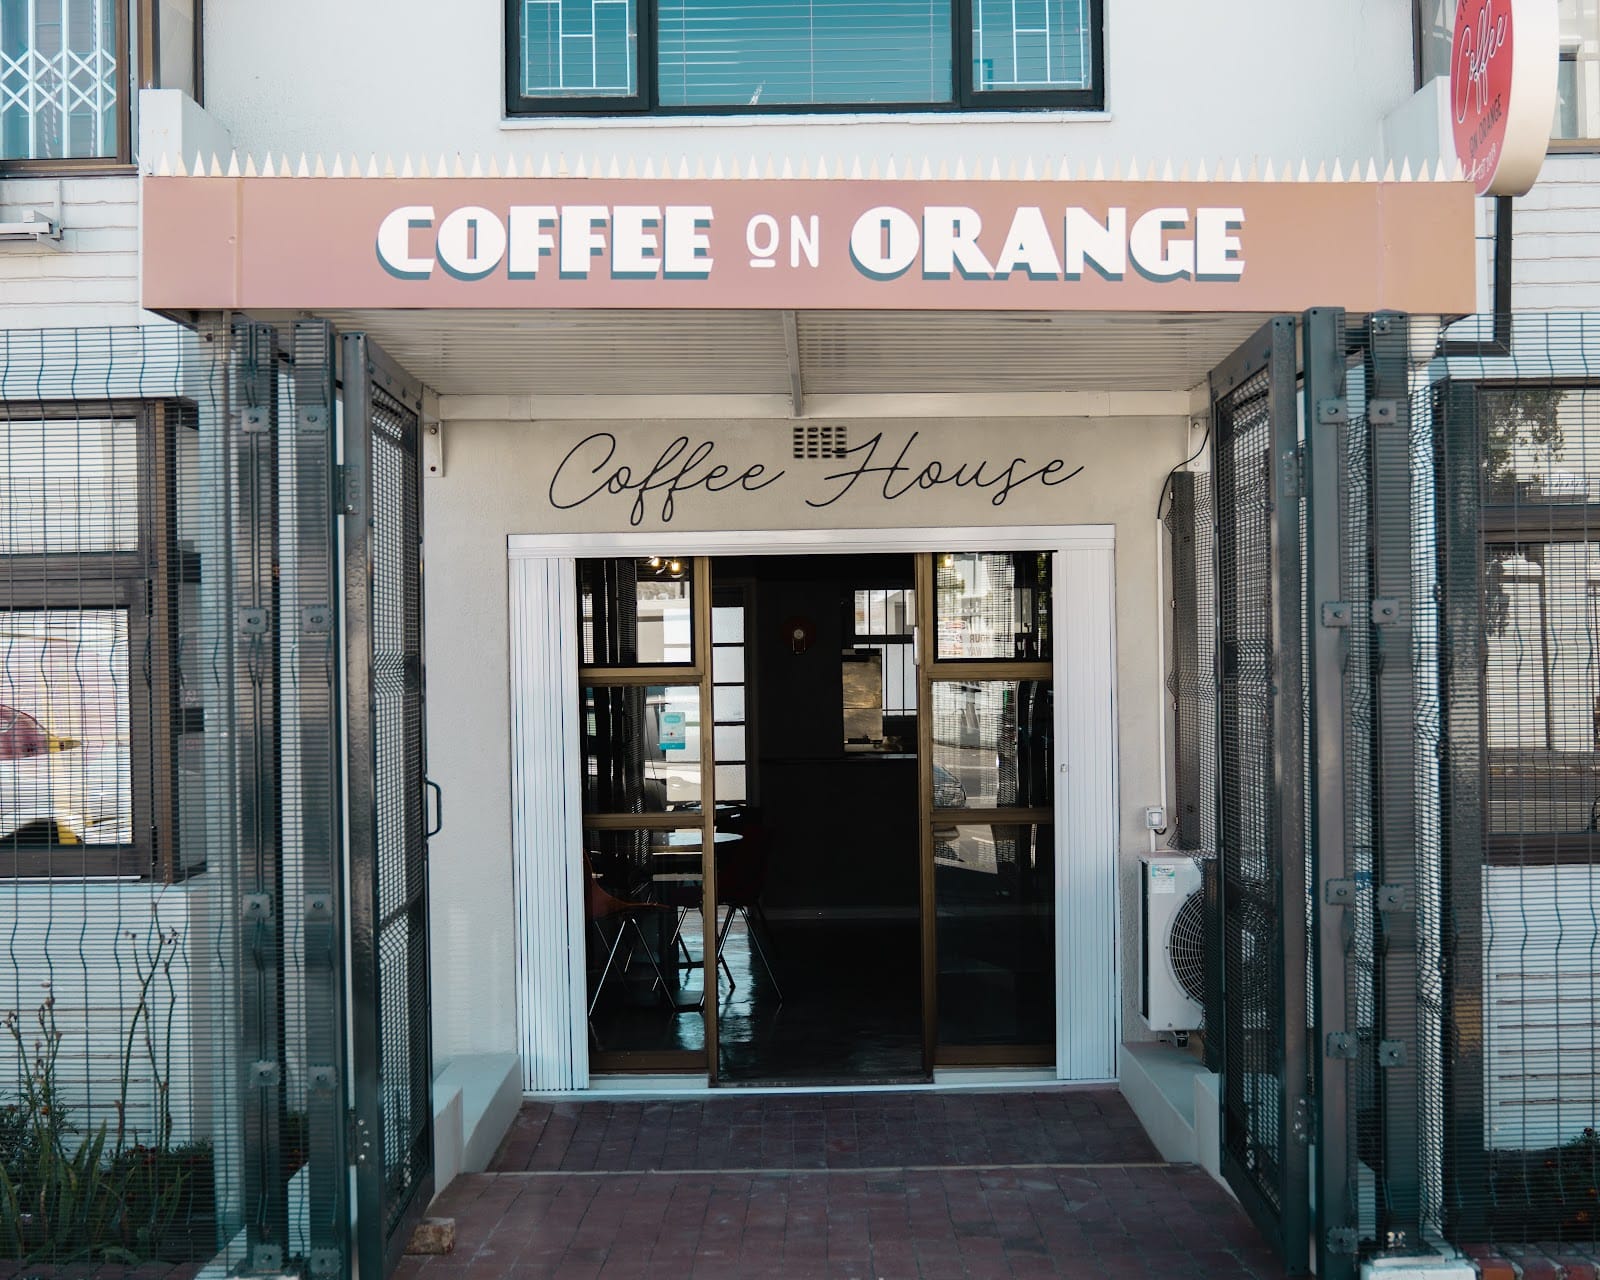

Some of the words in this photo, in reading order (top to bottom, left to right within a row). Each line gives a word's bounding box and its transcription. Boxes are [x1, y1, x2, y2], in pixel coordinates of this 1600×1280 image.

[1456, 0, 1507, 124] Coffee
[376, 205, 714, 282] COFFEE
[746, 213, 819, 268] ON
[849, 205, 1245, 284] ORANGE
[549, 432, 785, 526] Coffee
[805, 431, 1084, 507] House
